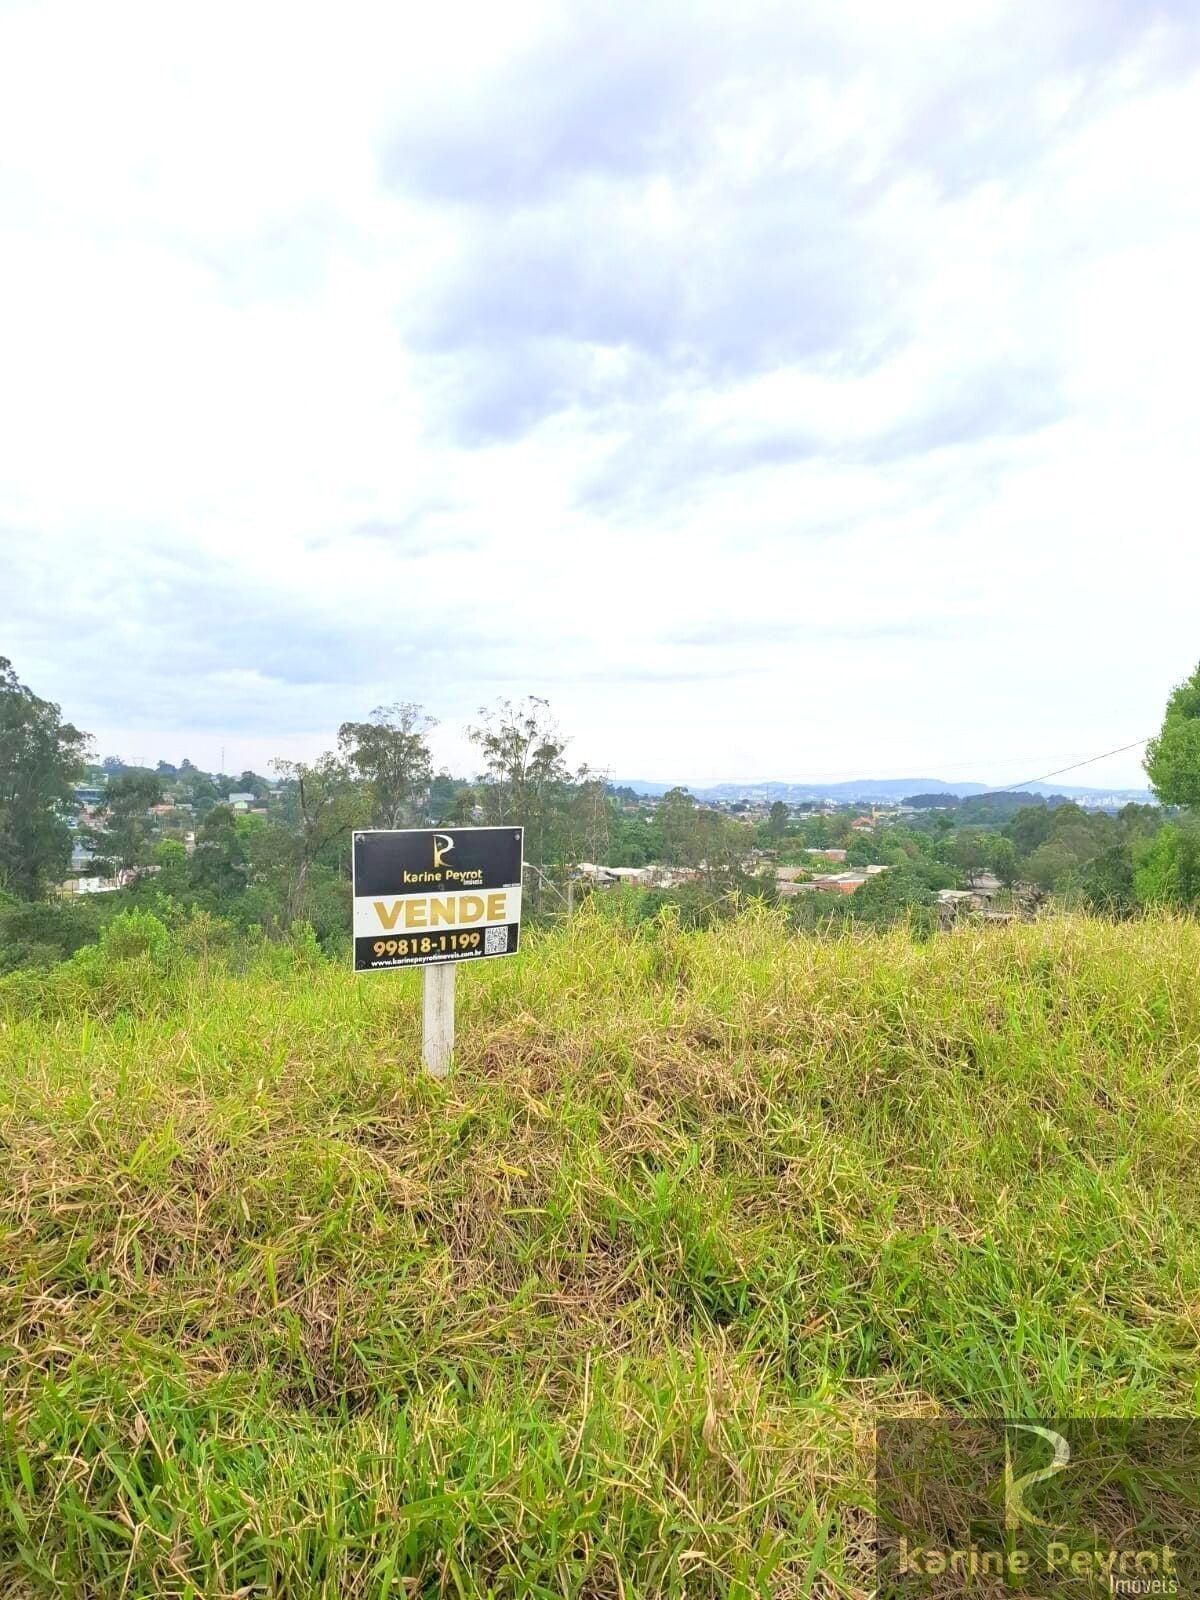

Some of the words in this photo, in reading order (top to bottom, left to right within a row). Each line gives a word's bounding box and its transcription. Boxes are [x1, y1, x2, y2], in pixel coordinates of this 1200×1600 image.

[446, 869, 483, 882] Peyrot
[373, 893, 507, 930] VENDE
[373, 933, 480, 957] 99818-1199
